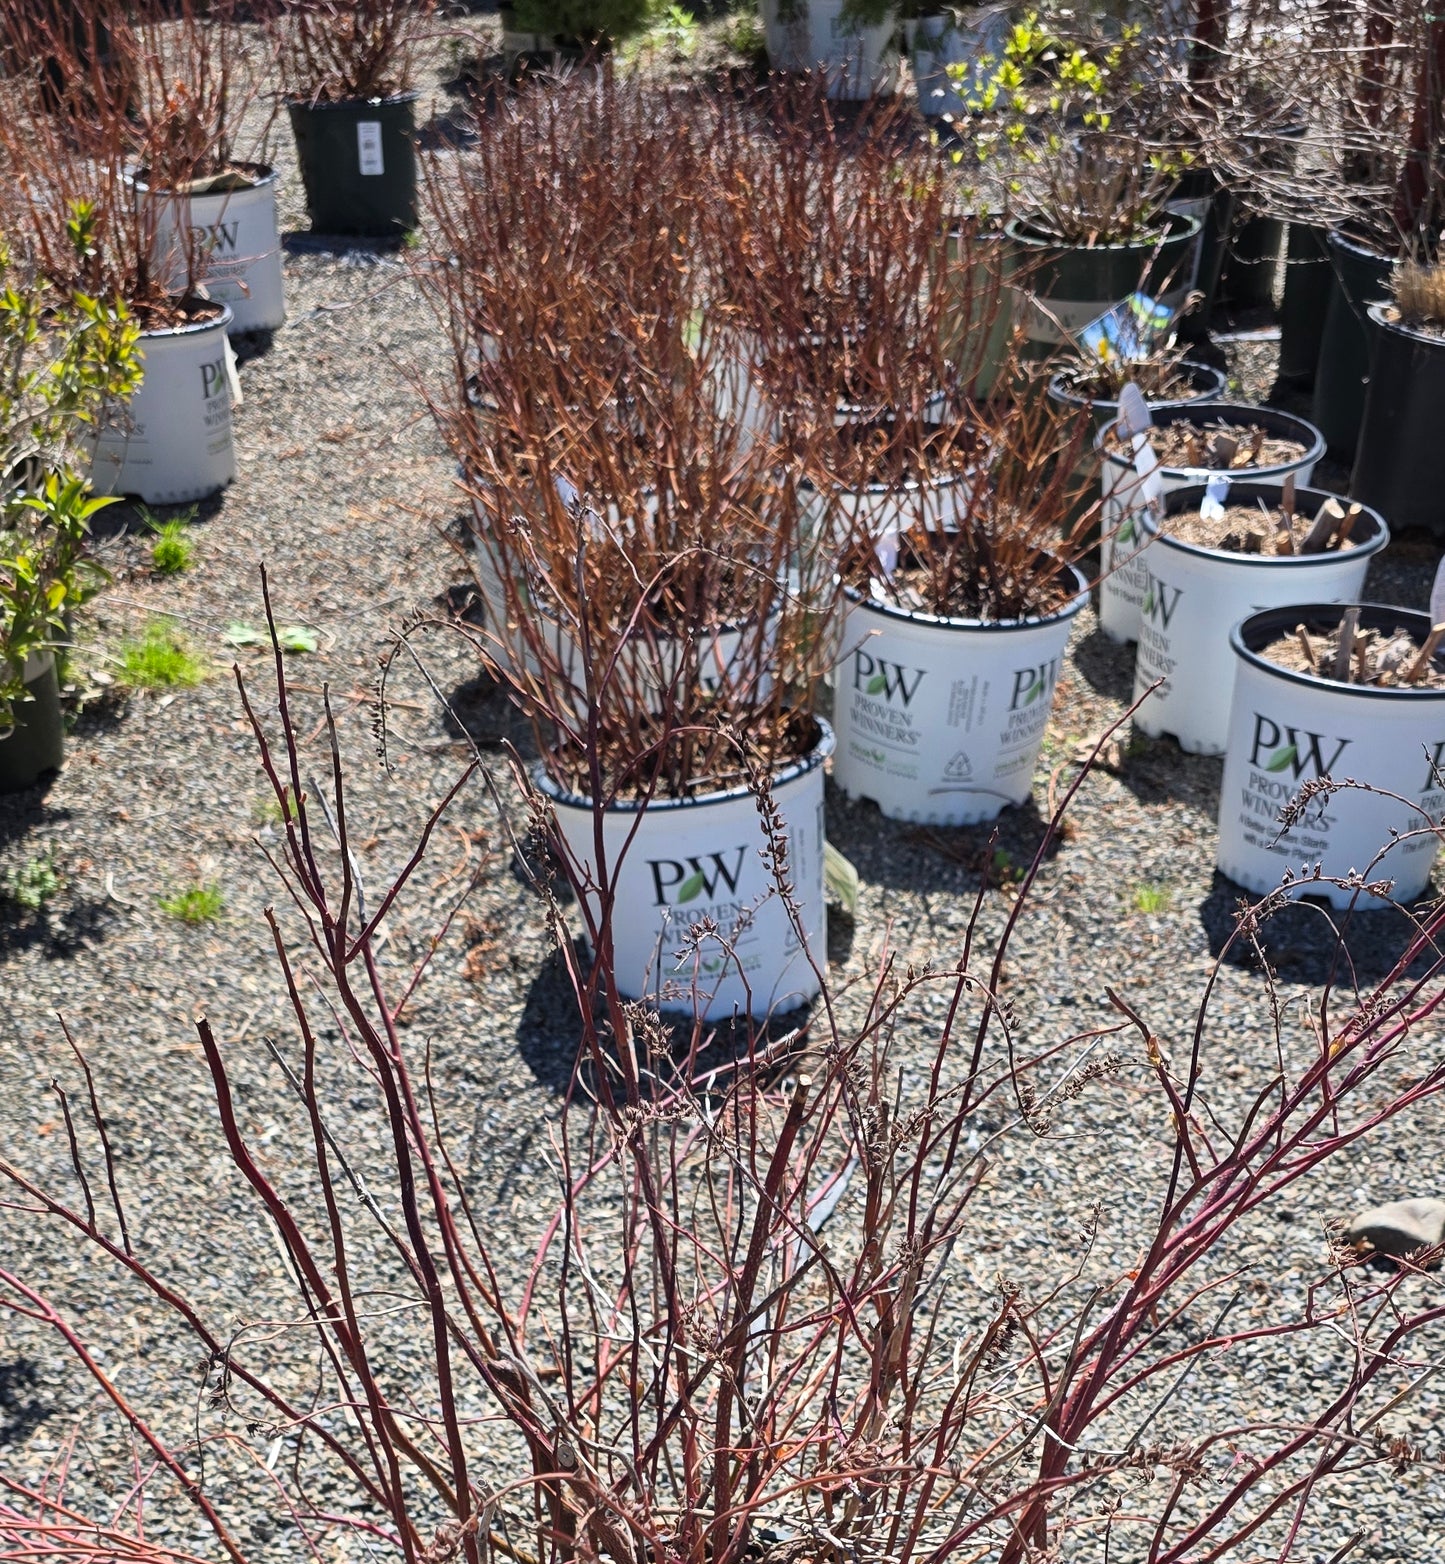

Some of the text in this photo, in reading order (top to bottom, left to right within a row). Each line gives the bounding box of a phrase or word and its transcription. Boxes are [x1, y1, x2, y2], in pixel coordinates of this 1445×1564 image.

[1147, 573, 1184, 631] W
[853, 650, 928, 708] PW
[854, 694, 914, 727] PROVEN
[1249, 712, 1354, 780] PW
[646, 845, 750, 906] PW
[663, 901, 744, 927] ROVEN
